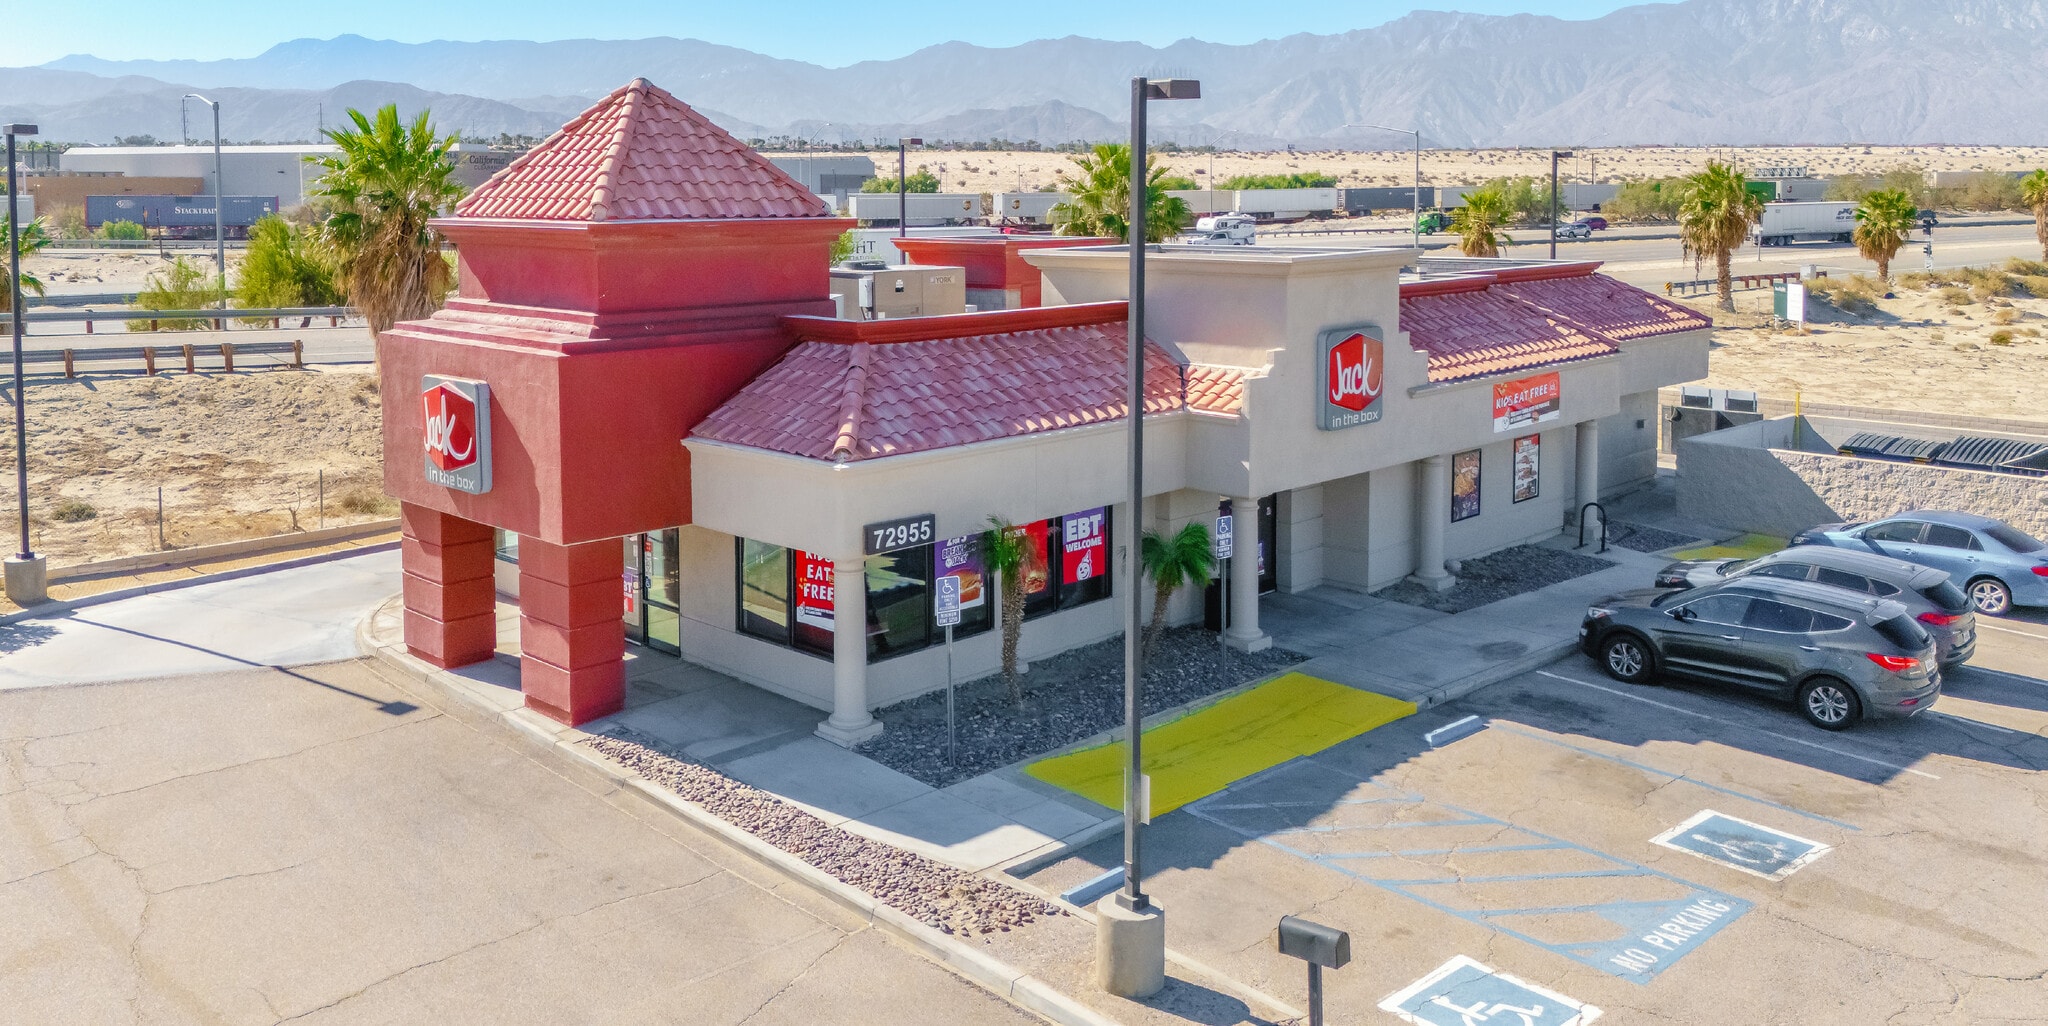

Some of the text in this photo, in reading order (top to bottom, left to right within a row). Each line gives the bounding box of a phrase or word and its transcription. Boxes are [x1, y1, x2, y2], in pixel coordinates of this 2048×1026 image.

[935, 276, 952, 284] YORK
[1332, 343, 1382, 401] Jack
[1496, 395, 1513, 409] KIDS
[1513, 389, 1528, 404] EAT
[1530, 384, 1548, 399] FREE
[424, 394, 472, 461] Jack
[1332, 410, 1378, 428] in the box
[429, 466, 474, 490] in the box
[874, 521, 931, 550] 72955
[1066, 514, 1102, 543] EBT
[1066, 536, 1103, 553] WELCOME
[807, 564, 831, 581] EAT
[803, 583, 834, 601] FREE
[1610, 899, 1731, 973] NO PARKING
